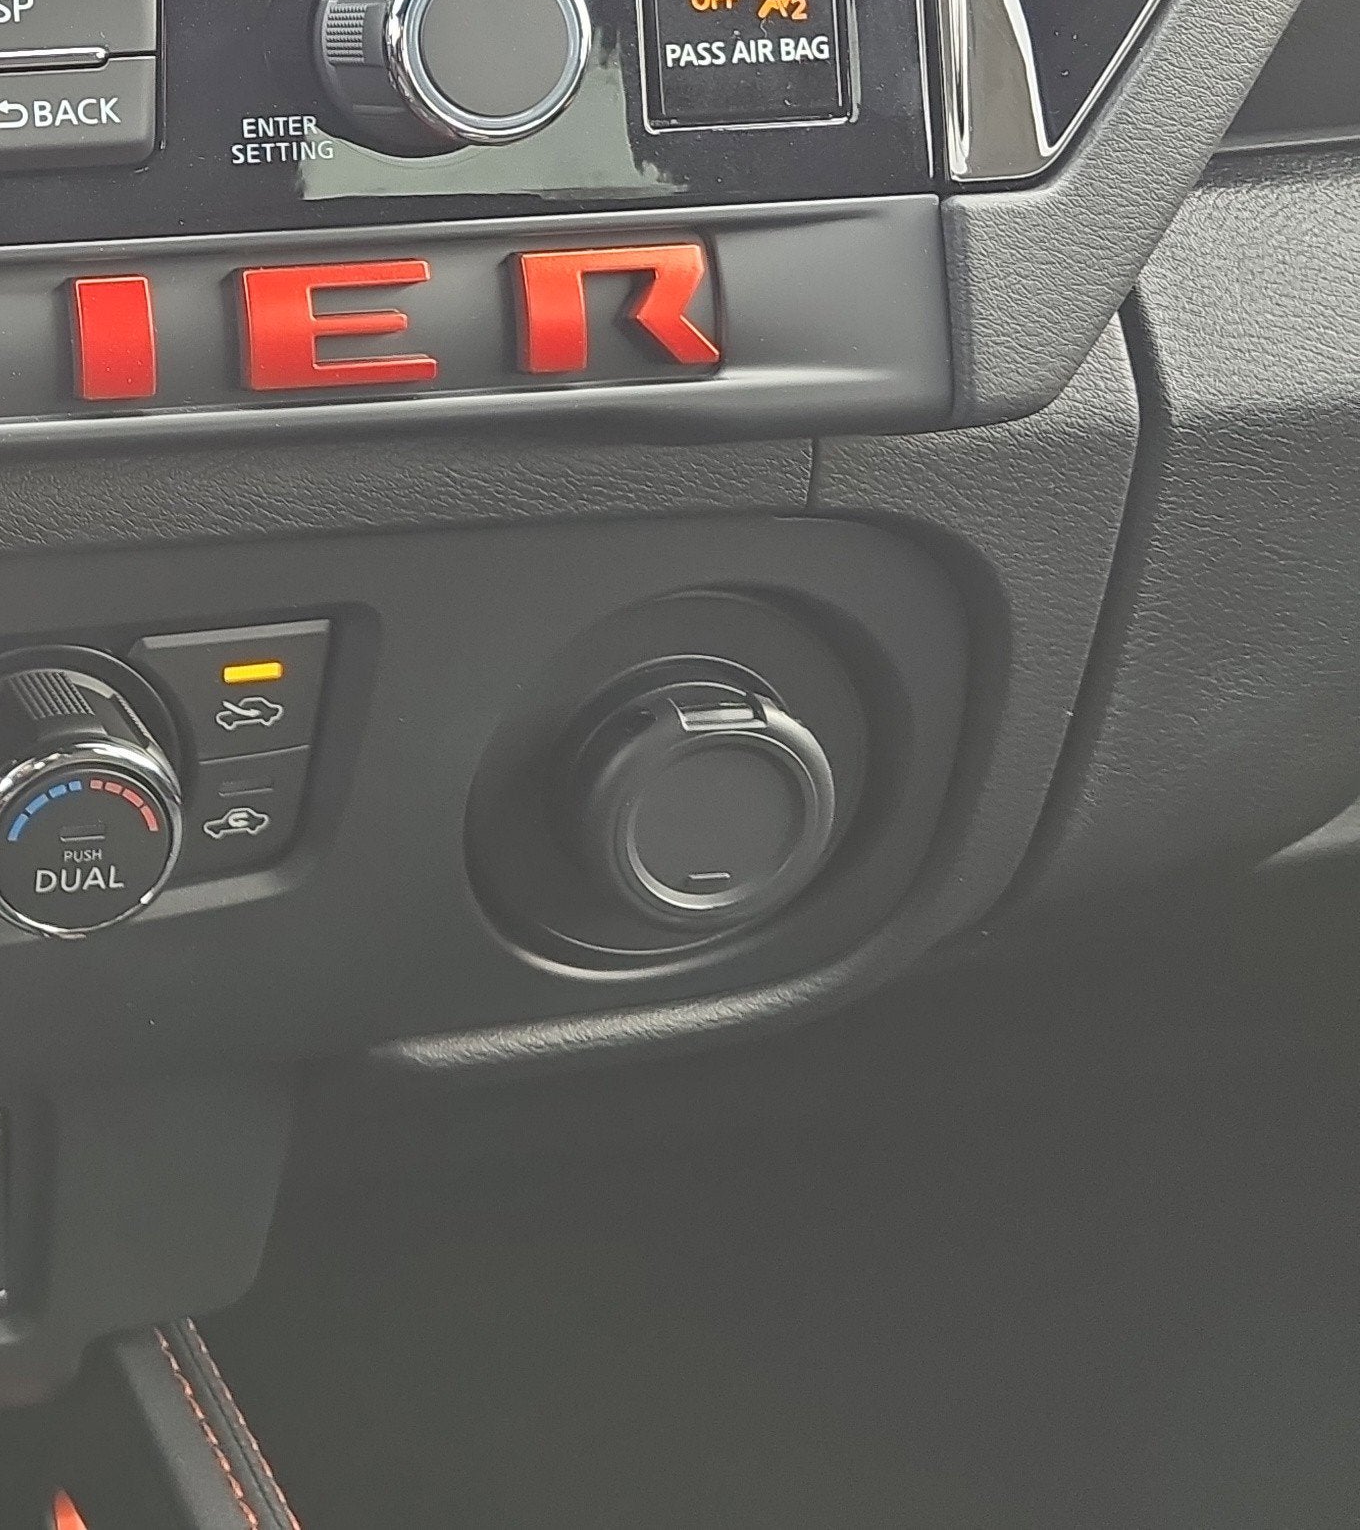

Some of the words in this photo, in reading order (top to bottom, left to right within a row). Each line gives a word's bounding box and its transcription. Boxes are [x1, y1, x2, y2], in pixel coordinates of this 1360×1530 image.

[665, 41, 726, 68] PASS
[732, 39, 775, 64] AIR
[780, 35, 830, 62] BAG
[34, 97, 120, 128] BACK
[242, 115, 318, 140] ENTER
[232, 138, 334, 165] SETTING
[63, 847, 103, 864] PUSH
[34, 864, 124, 895] DUAL
